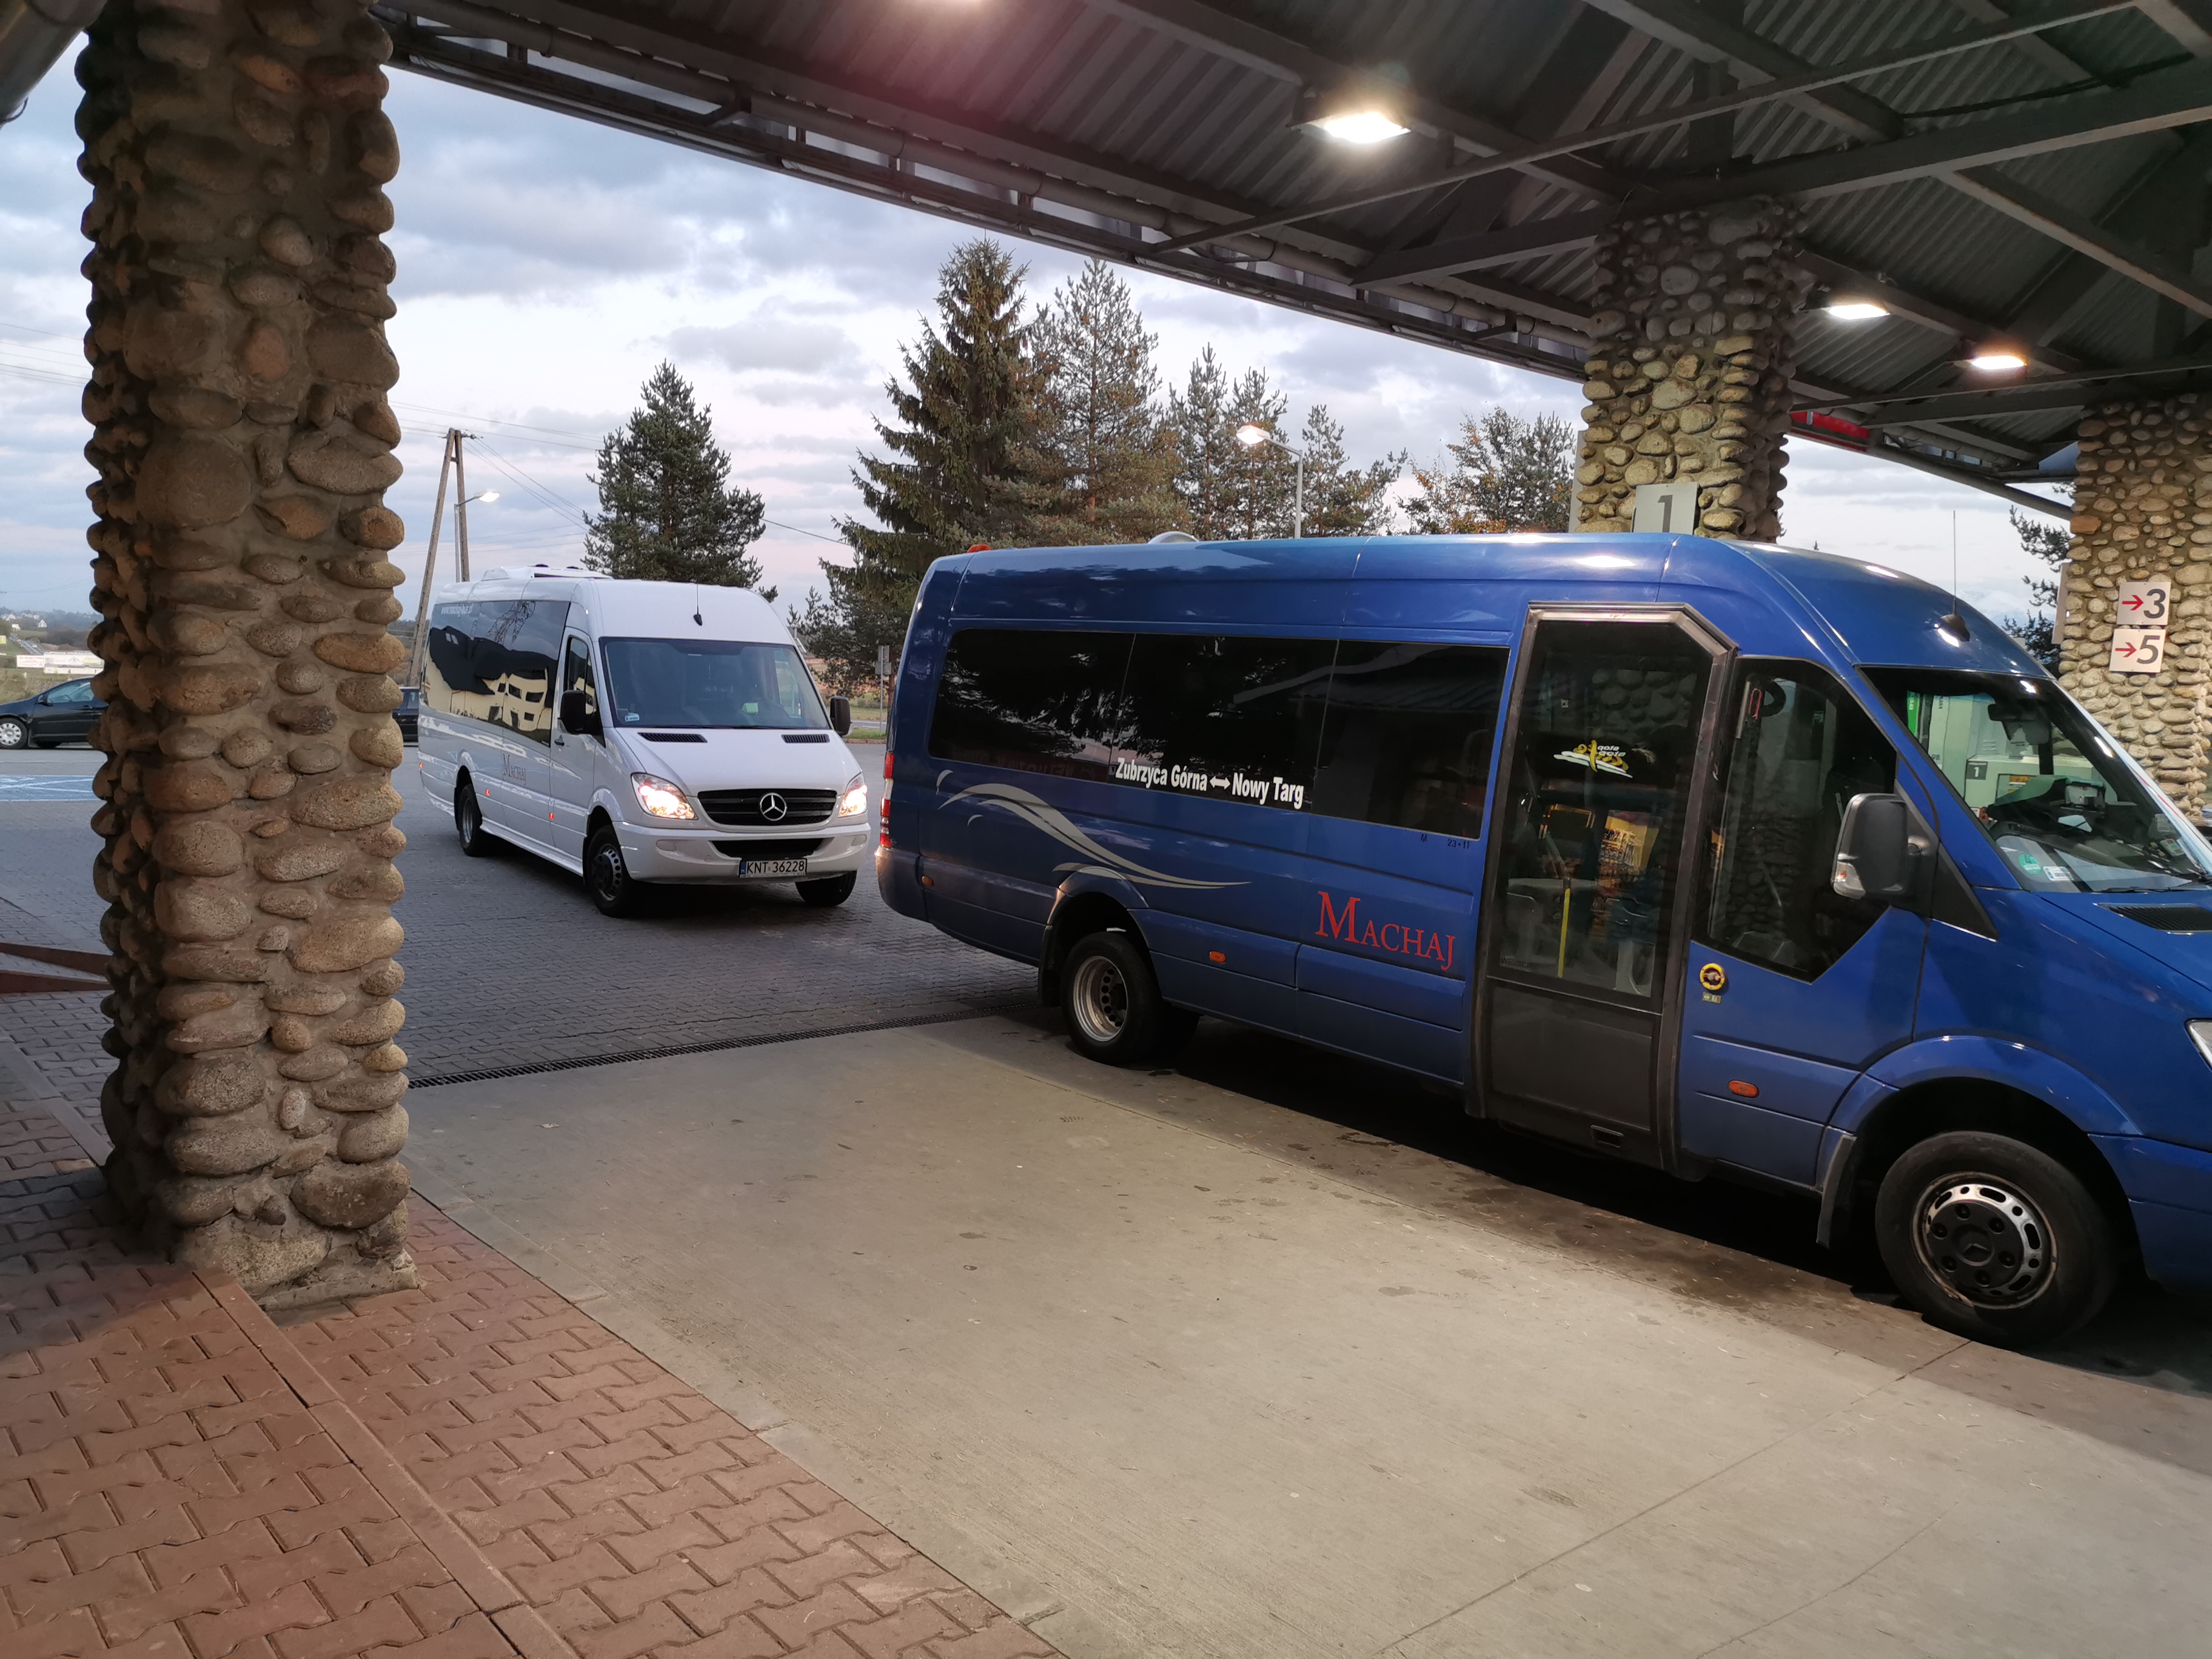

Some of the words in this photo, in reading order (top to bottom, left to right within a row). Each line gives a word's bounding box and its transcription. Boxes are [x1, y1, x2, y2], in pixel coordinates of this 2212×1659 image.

[1657, 494, 1673, 532] 1
[2143, 588, 2167, 619] 3
[2136, 635, 2161, 665] 5
[1115, 757, 1168, 789] Zubrzyca
[1170, 764, 1208, 792] Górna
[1232, 772, 1270, 805] Nowy
[1273, 776, 1304, 810] Targ
[1974, 766, 1980, 777] 1
[746, 862, 769, 874] KNT
[772, 860, 805, 873] 36228
